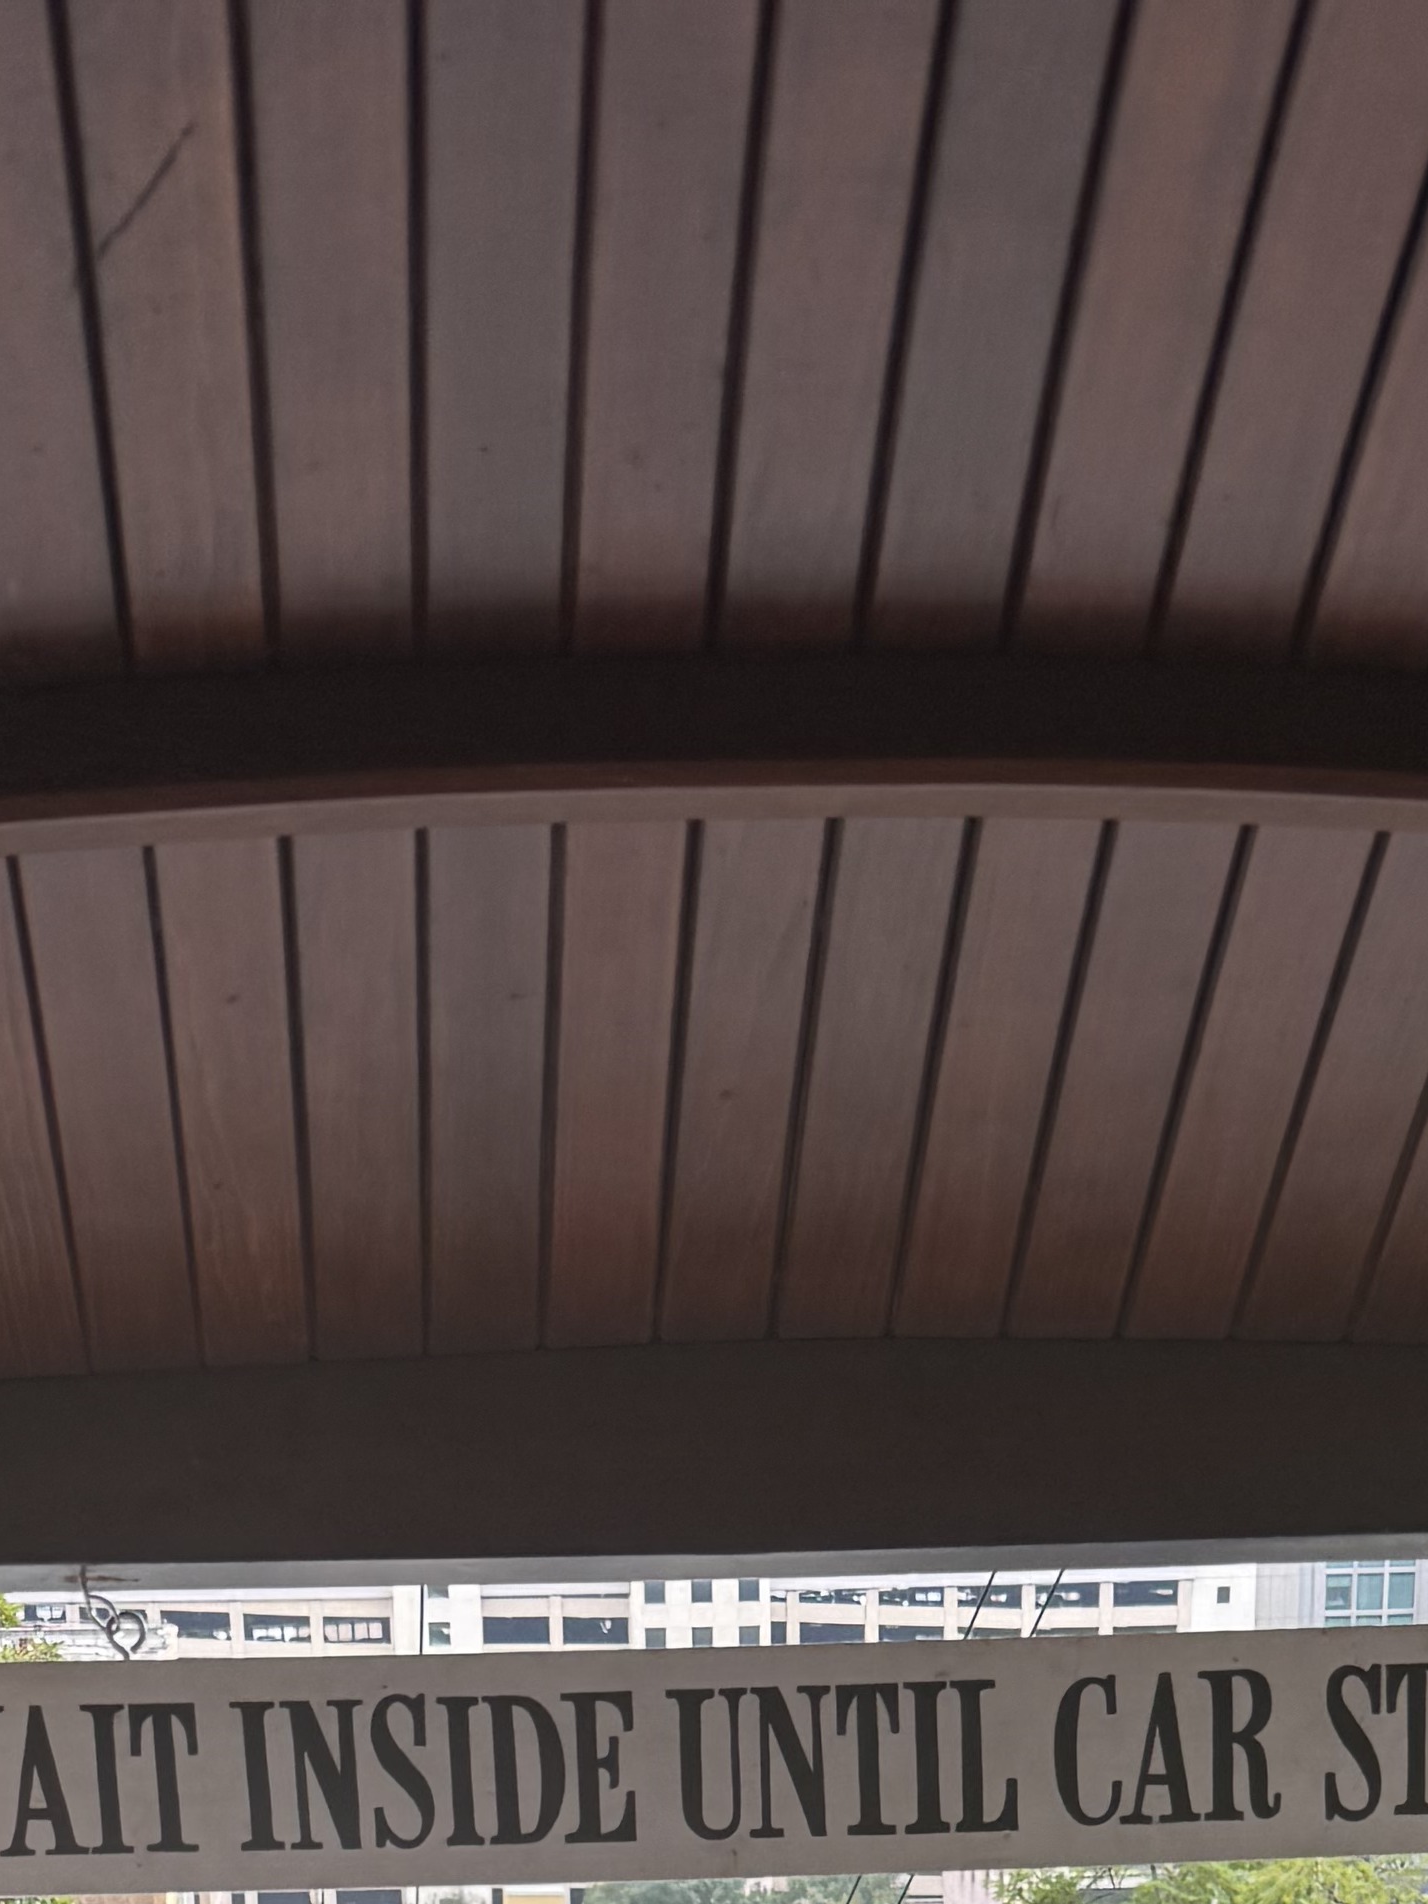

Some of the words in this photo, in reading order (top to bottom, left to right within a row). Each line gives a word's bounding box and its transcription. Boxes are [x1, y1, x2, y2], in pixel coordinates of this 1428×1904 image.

[228, 1690, 638, 1852] INSIDE
[664, 1678, 1020, 1841] UNTIL
[1053, 1668, 1282, 1827] CAR
